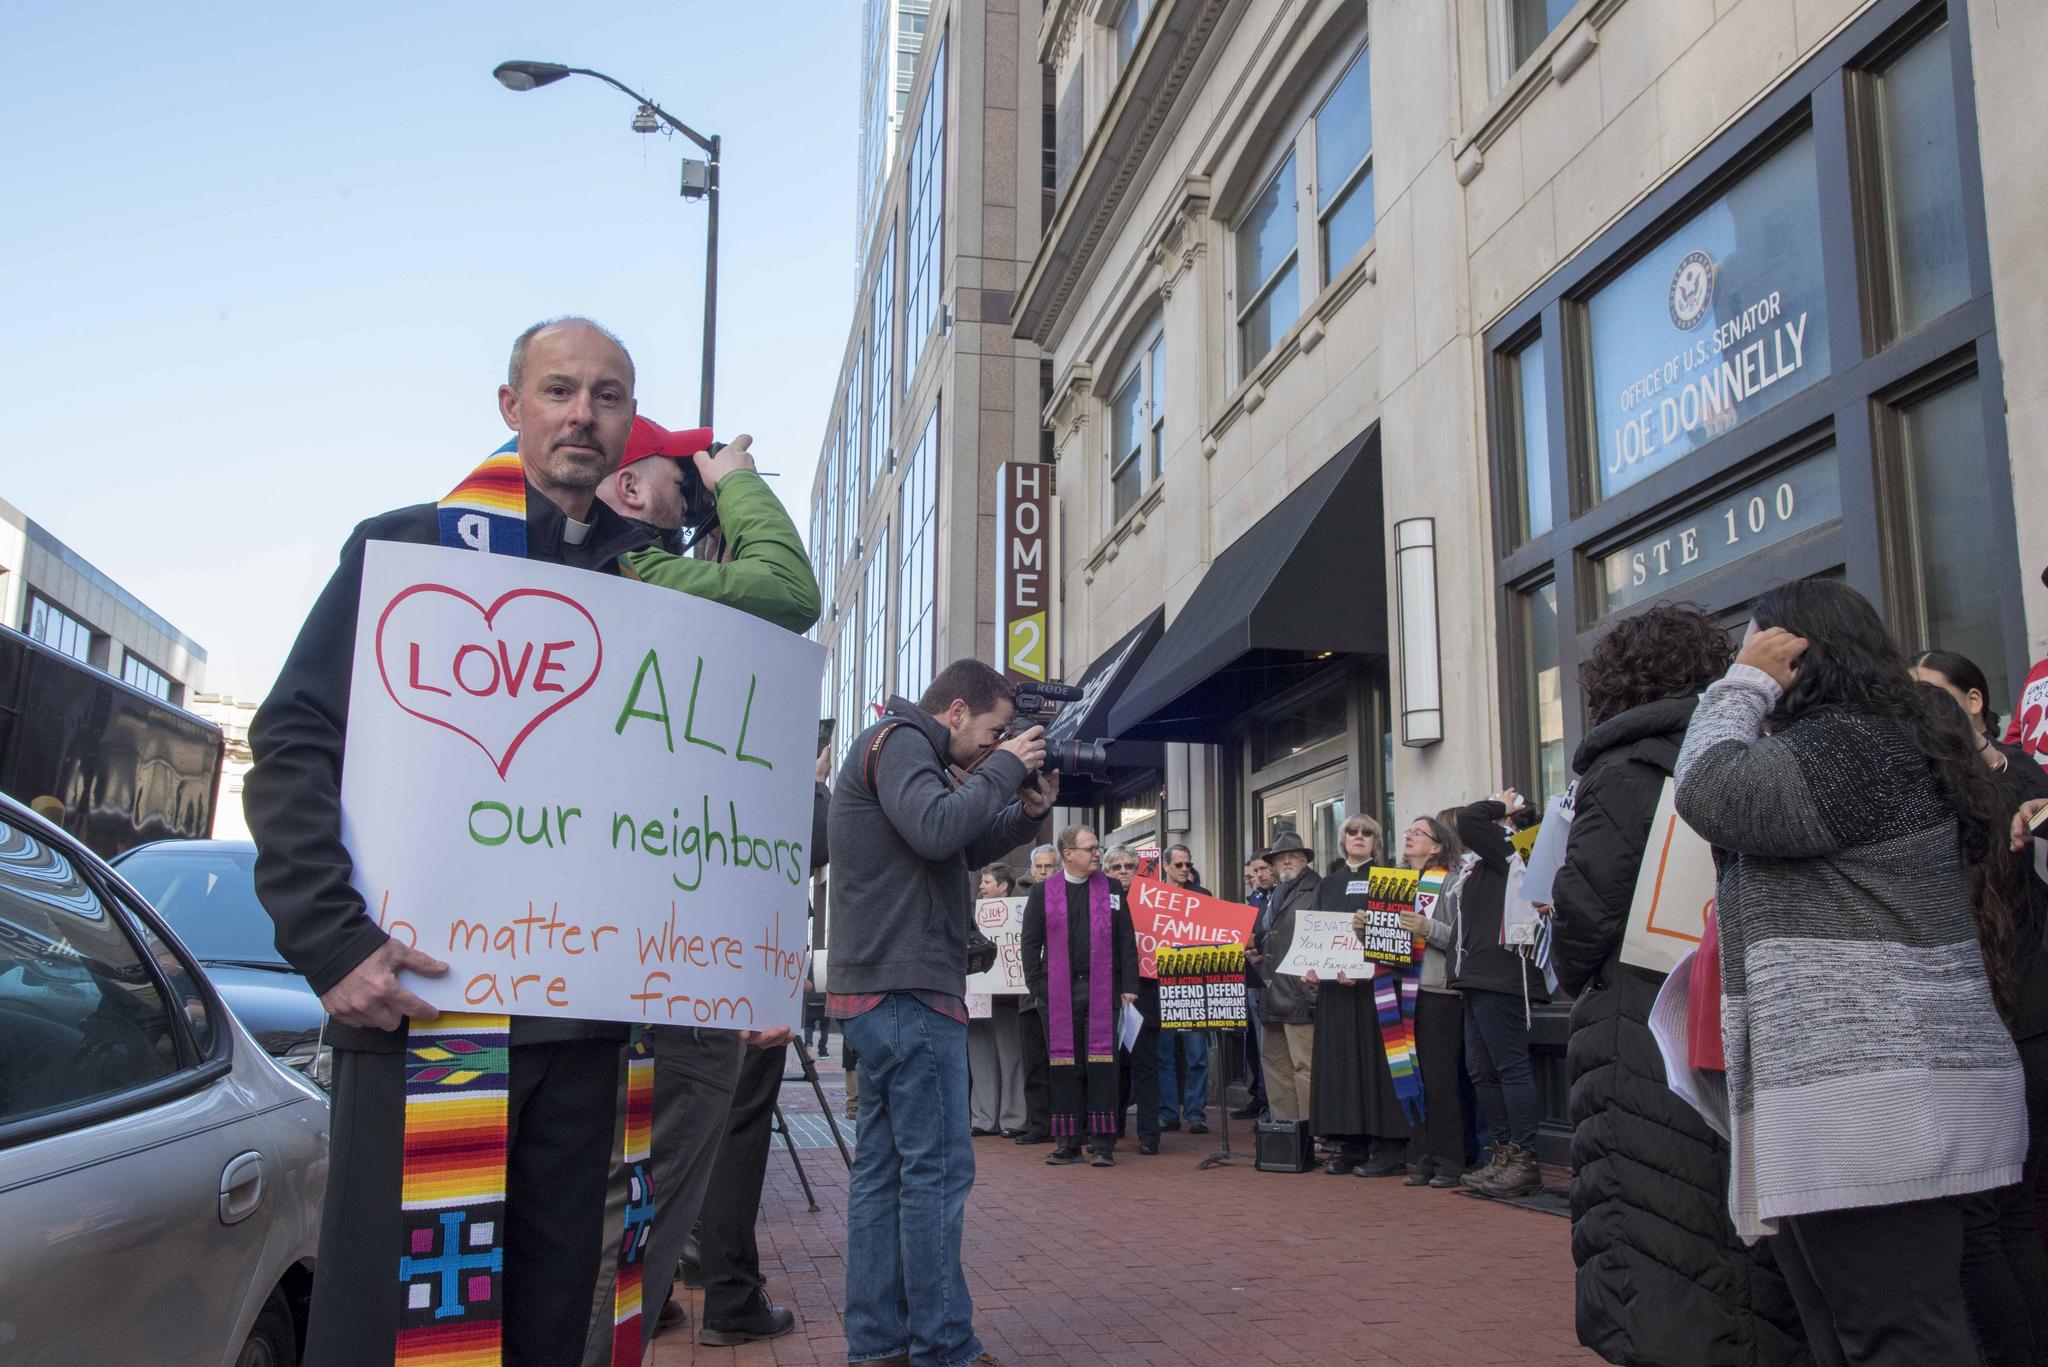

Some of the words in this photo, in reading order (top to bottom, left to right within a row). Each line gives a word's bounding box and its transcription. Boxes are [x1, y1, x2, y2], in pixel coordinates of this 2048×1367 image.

[1620, 368, 1662, 412] OFFICE
[1664, 354, 1680, 386] OF
[1684, 339, 1710, 374] U.S.
[1712, 290, 1781, 354] SENATOR
[1608, 408, 1655, 474] JOE
[1662, 312, 1808, 444] DONNELLY
[1012, 466, 1042, 608] HOME
[1632, 527, 1699, 587] STE
[1724, 482, 1794, 546] 100
[1013, 620, 1041, 674] 2
[408, 640, 576, 698] LOVE
[614, 648, 774, 772] ALL
[468, 801, 582, 848] our
[612, 795, 802, 891] neighbors
[1140, 883, 1200, 918] KEEP
[1368, 900, 1385, 910] TAKE
[1386, 902, 1414, 912] ACTION
[1152, 914, 1242, 944] FAMILIES
[448, 901, 619, 960] matter
[638, 900, 742, 968] where
[755, 911, 806, 998] they
[1365, 936, 1411, 955] FAMILIES
[1365, 951, 1384, 959] MARCH
[464, 972, 569, 1006] are
[630, 972, 754, 1024] from
[1160, 985, 1204, 999] DEFEND
[1160, 999, 1205, 1008] IMMIGRANT
[1206, 983, 1245, 997] DEFEND
[1207, 997, 1246, 1007] IMMIGRANT
[1161, 1008, 1206, 1021] FAMILIES
[1208, 1007, 1246, 1020] FAMILIES
